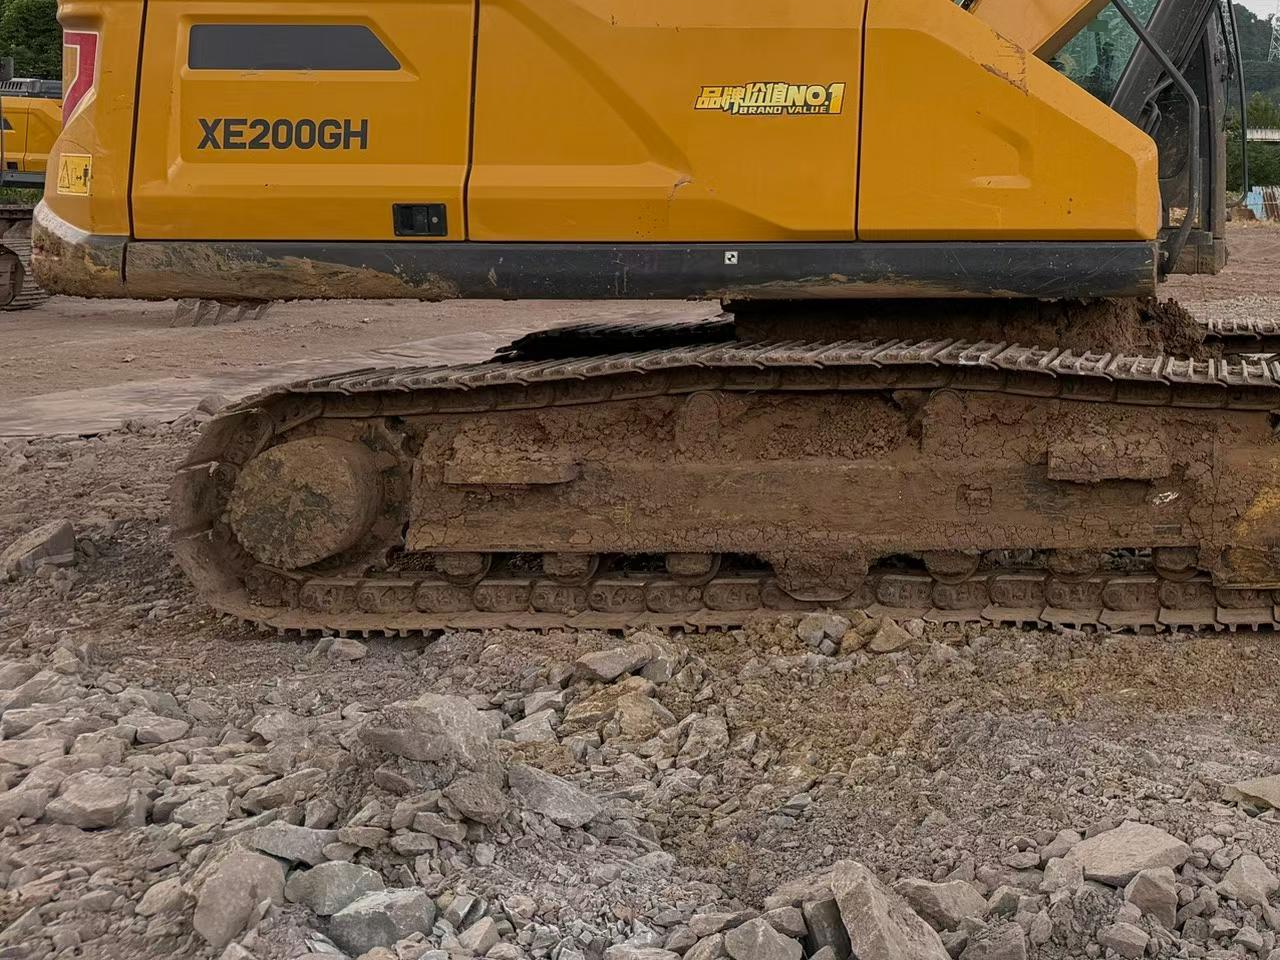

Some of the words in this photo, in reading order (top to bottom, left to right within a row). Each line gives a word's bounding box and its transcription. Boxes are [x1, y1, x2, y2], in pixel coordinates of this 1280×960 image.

[738, 105, 783, 114] BRAND
[787, 105, 828, 114] VALUE
[197, 118, 369, 150] XE200GH
